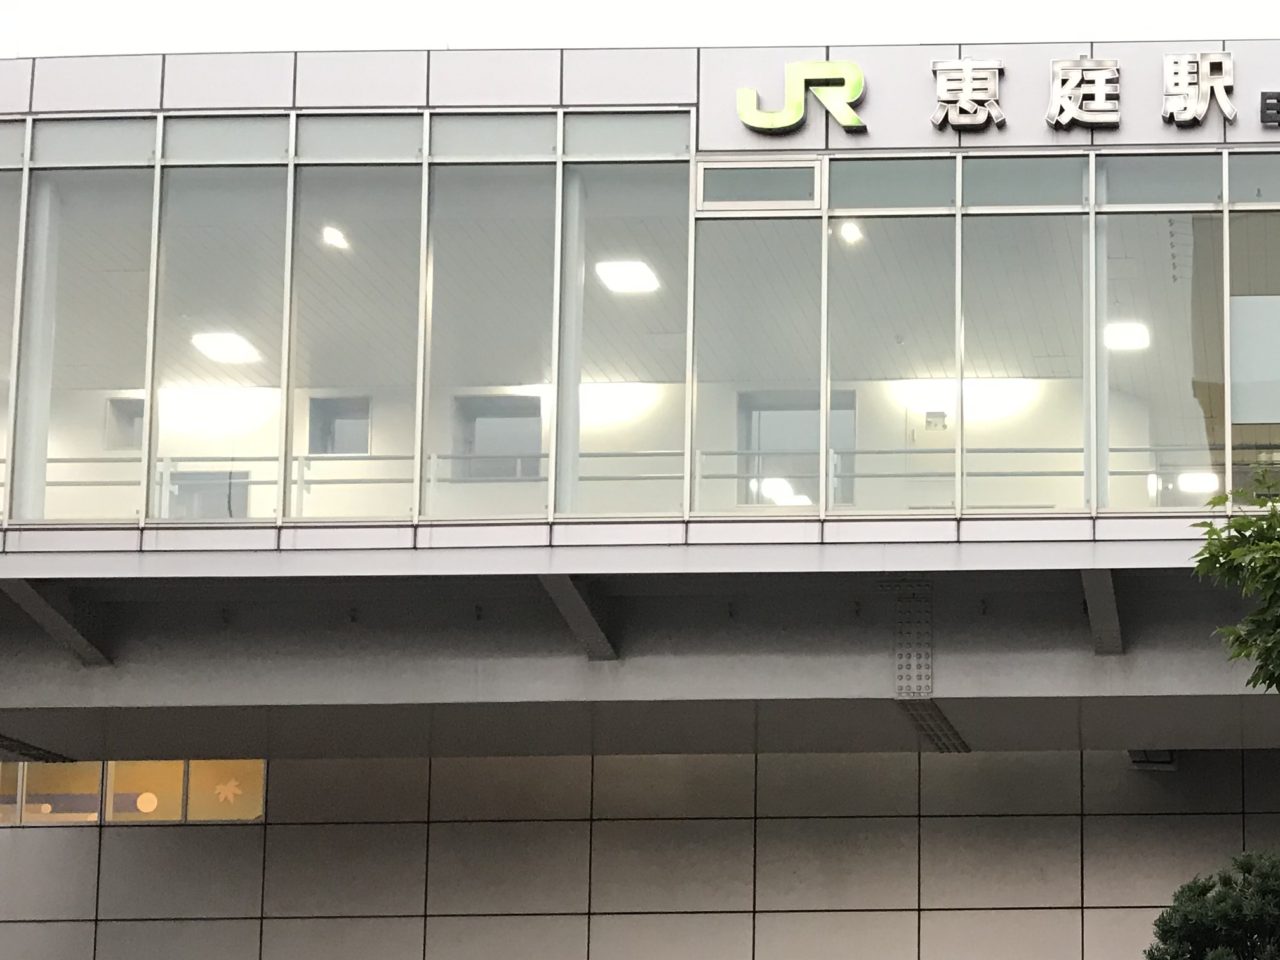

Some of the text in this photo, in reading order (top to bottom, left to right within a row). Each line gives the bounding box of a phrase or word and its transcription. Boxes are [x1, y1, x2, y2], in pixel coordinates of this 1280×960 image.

[736, 59, 867, 131] JR
[929, 51, 1238, 130] 恵庭駅
